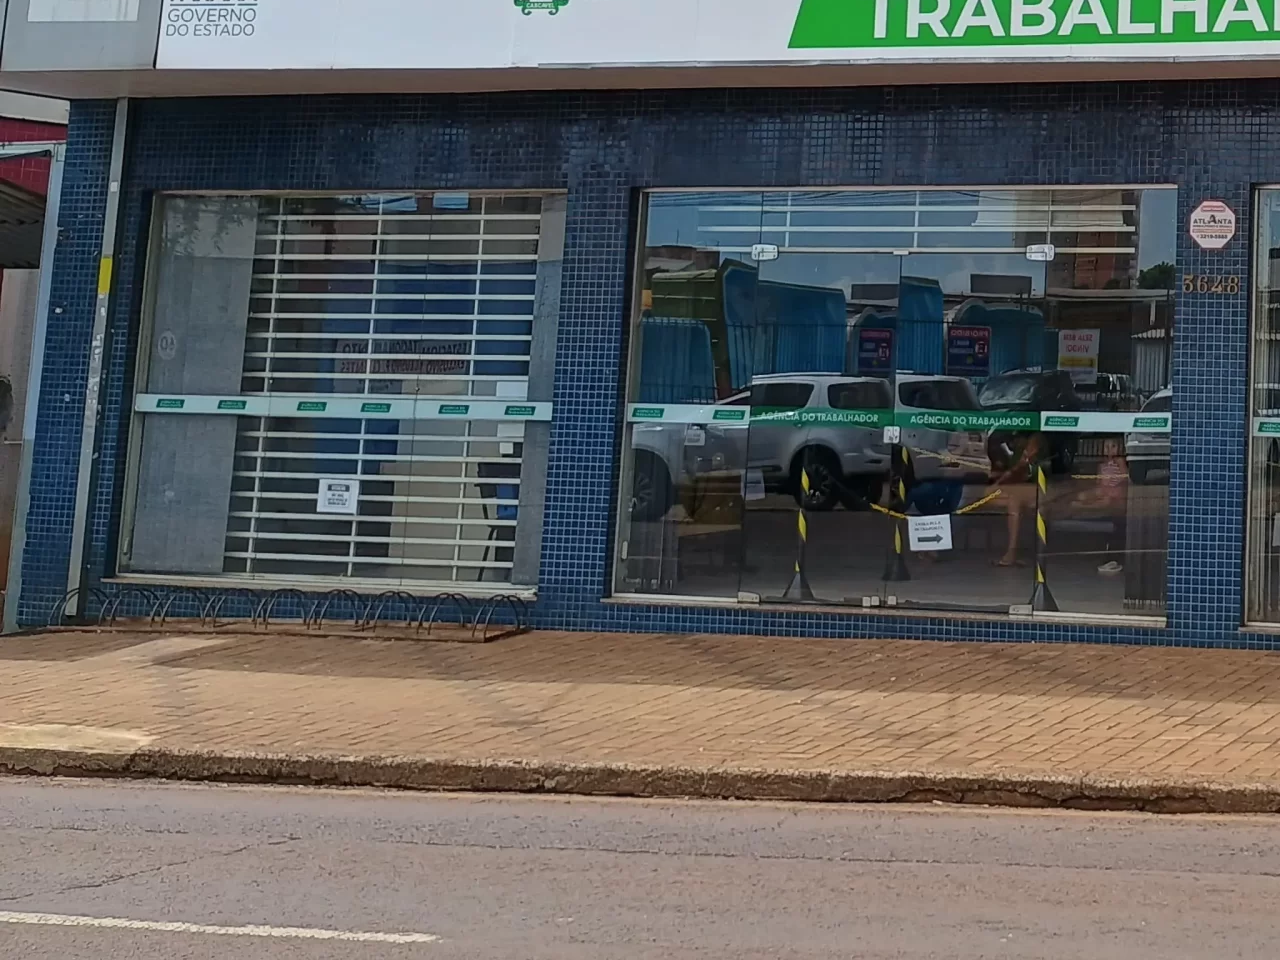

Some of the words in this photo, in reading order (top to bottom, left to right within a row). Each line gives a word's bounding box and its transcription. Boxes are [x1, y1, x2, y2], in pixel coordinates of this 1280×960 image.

[167, 7, 257, 23] GOVERNO
[165, 23, 190, 37] DO
[193, 23, 255, 37] ESTADO
[1192, 214, 1233, 225] ATLANTA
[760, 410, 800, 421] AGÊNCIA
[801, 412, 816, 422] DO
[817, 412, 879, 423] TRABALHADOR
[910, 414, 951, 424] AGÊNCIA
[952, 416, 966, 425] DO
[968, 416, 1031, 426] TRABALHADOR
